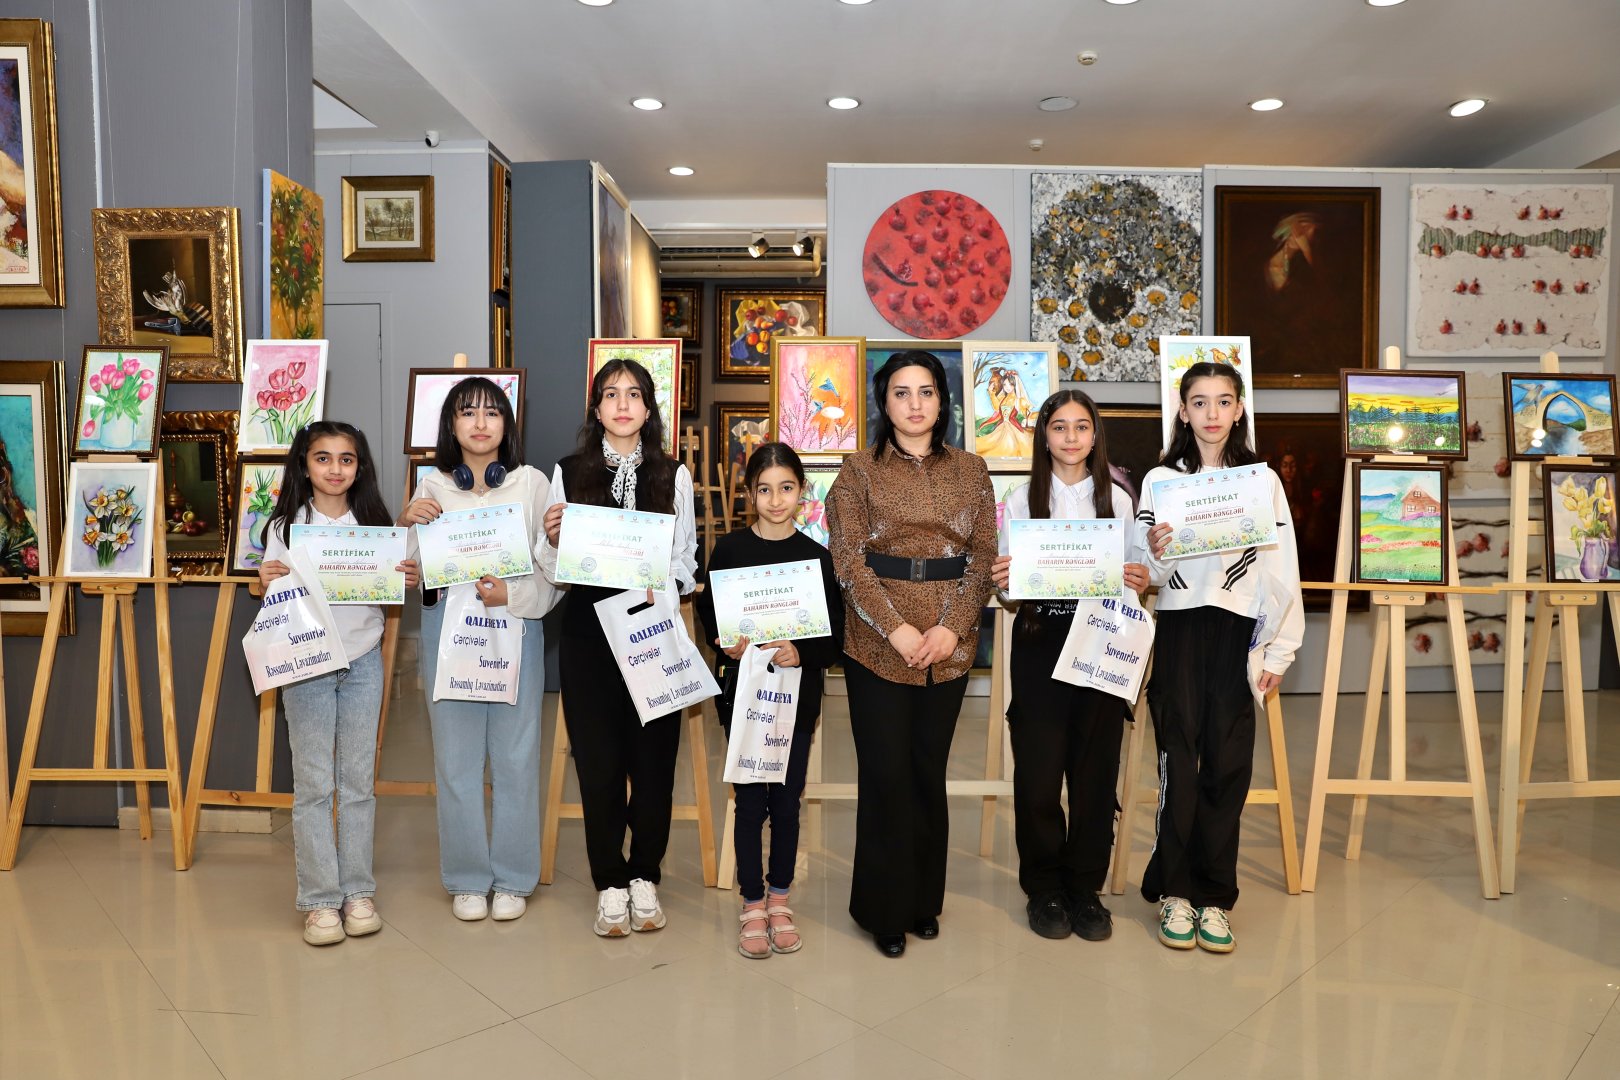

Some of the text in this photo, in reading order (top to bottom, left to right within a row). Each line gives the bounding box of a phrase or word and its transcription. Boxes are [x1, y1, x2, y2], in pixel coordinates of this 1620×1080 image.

[1185, 492, 1239, 508] SERTİFİKAT
[1185, 511, 1213, 522] BAHARIN
[448, 528, 497, 541] SERTİFİKAT
[322, 549, 376, 557] SERTİFİKAT
[1040, 543, 1092, 551] SERTİFİKAT
[743, 586, 795, 599] SERTİFİKAT
[743, 603, 770, 613] BAHARIN
[287, 626, 326, 646] Suvenirlər
[453, 634, 488, 647] Çərçivələr
[1104, 642, 1140, 665] Suvenirlər
